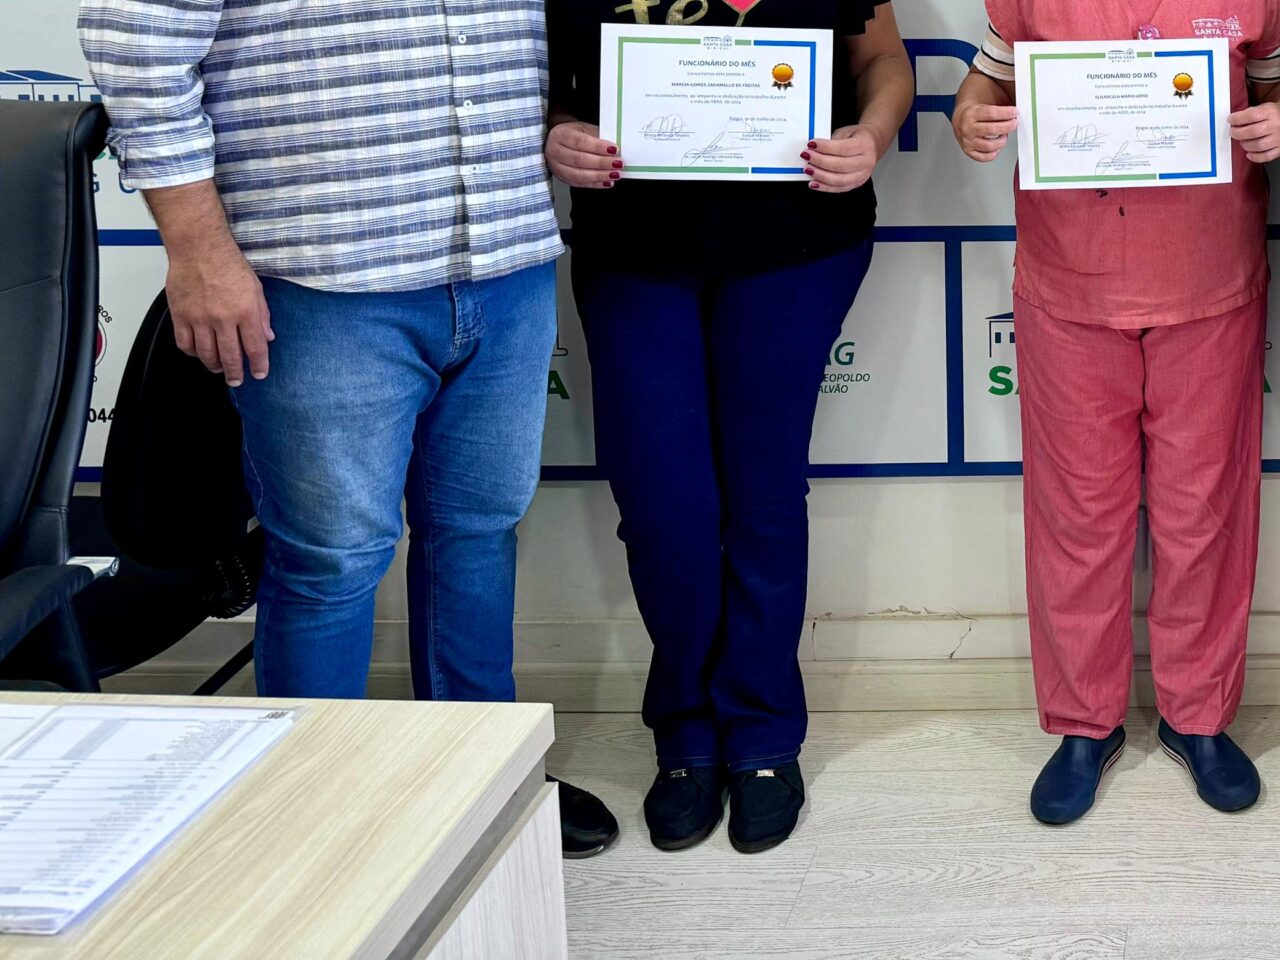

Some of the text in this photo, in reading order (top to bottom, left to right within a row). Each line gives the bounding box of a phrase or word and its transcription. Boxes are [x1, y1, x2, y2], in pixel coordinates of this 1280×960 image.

[1194, 28, 1243, 37] SANTA CASA
[679, 59, 727, 67] FUNCIONÁRIO
[1087, 72, 1131, 80] FUNCIONÁRIO
[823, 373, 870, 382] EOPOLDO
